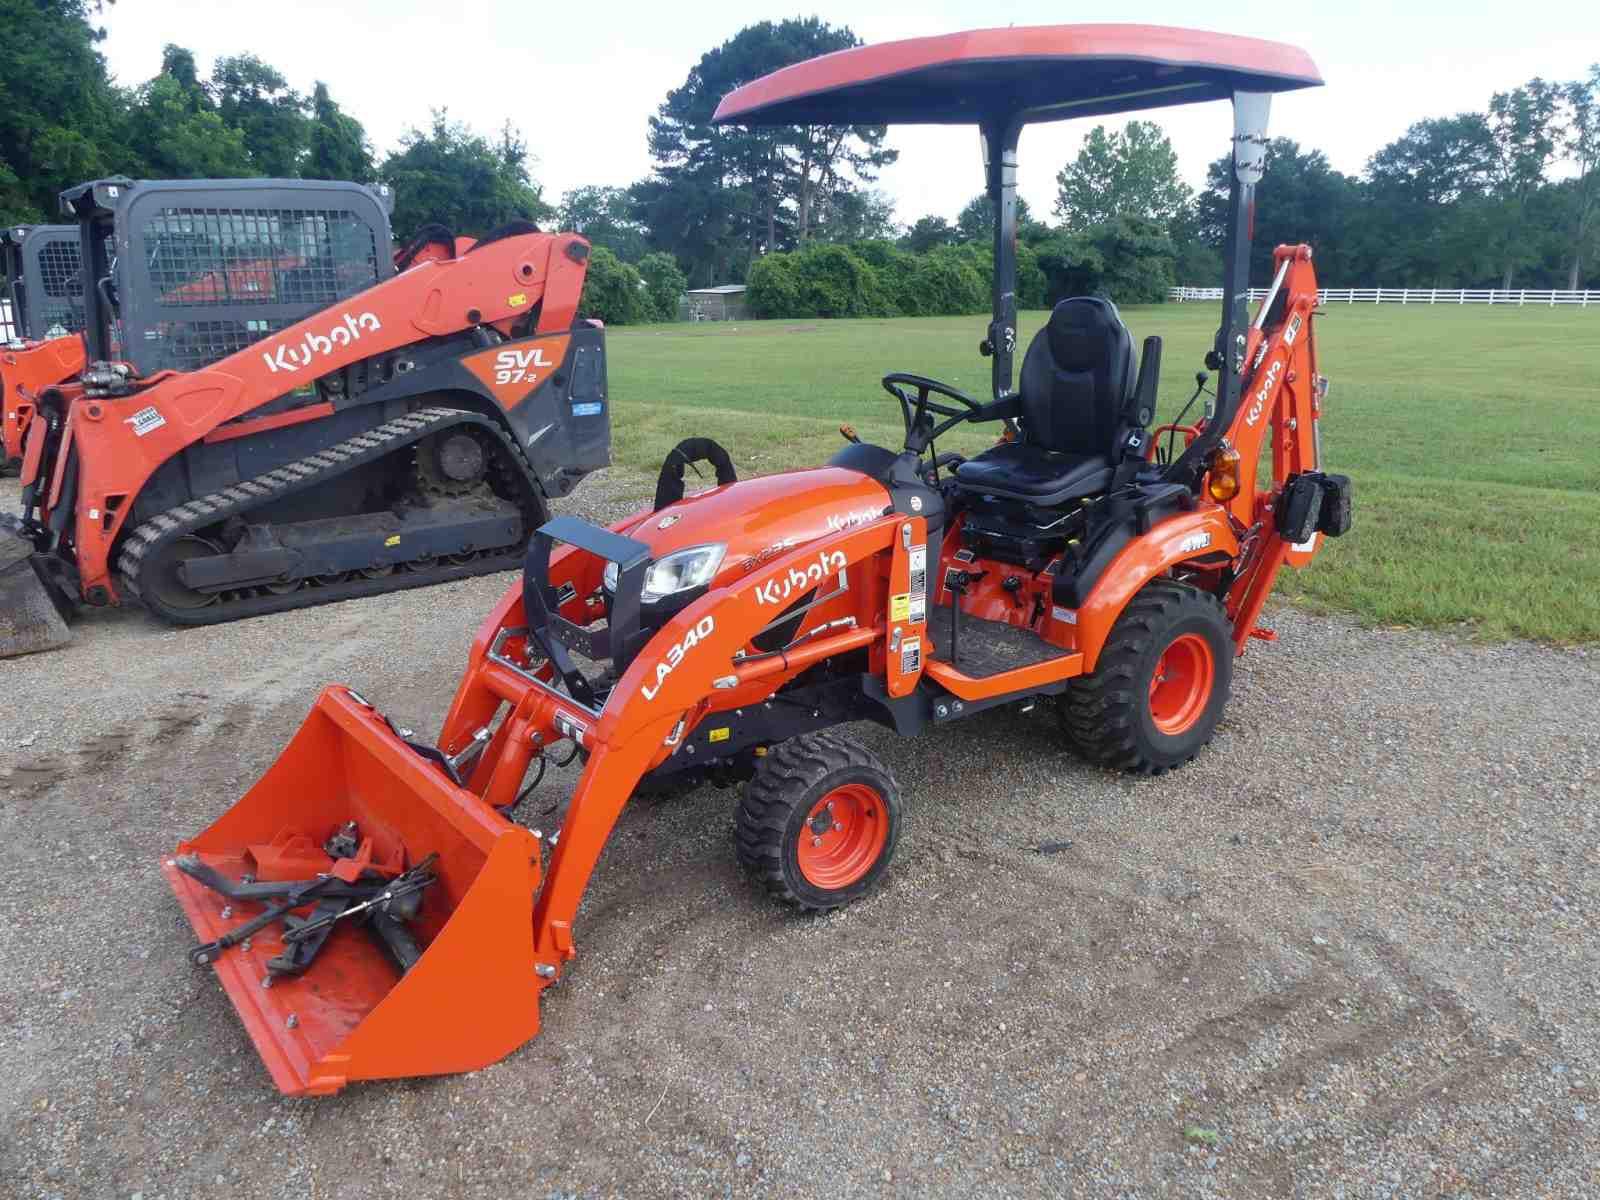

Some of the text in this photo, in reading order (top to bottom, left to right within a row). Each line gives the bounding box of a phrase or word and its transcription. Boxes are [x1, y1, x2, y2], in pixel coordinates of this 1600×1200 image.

[263, 312, 381, 372] Kubota
[494, 349, 553, 371] SVL
[1245, 360, 1281, 426] Kubota
[754, 550, 848, 605] Kubota
[640, 614, 715, 701] LA340
